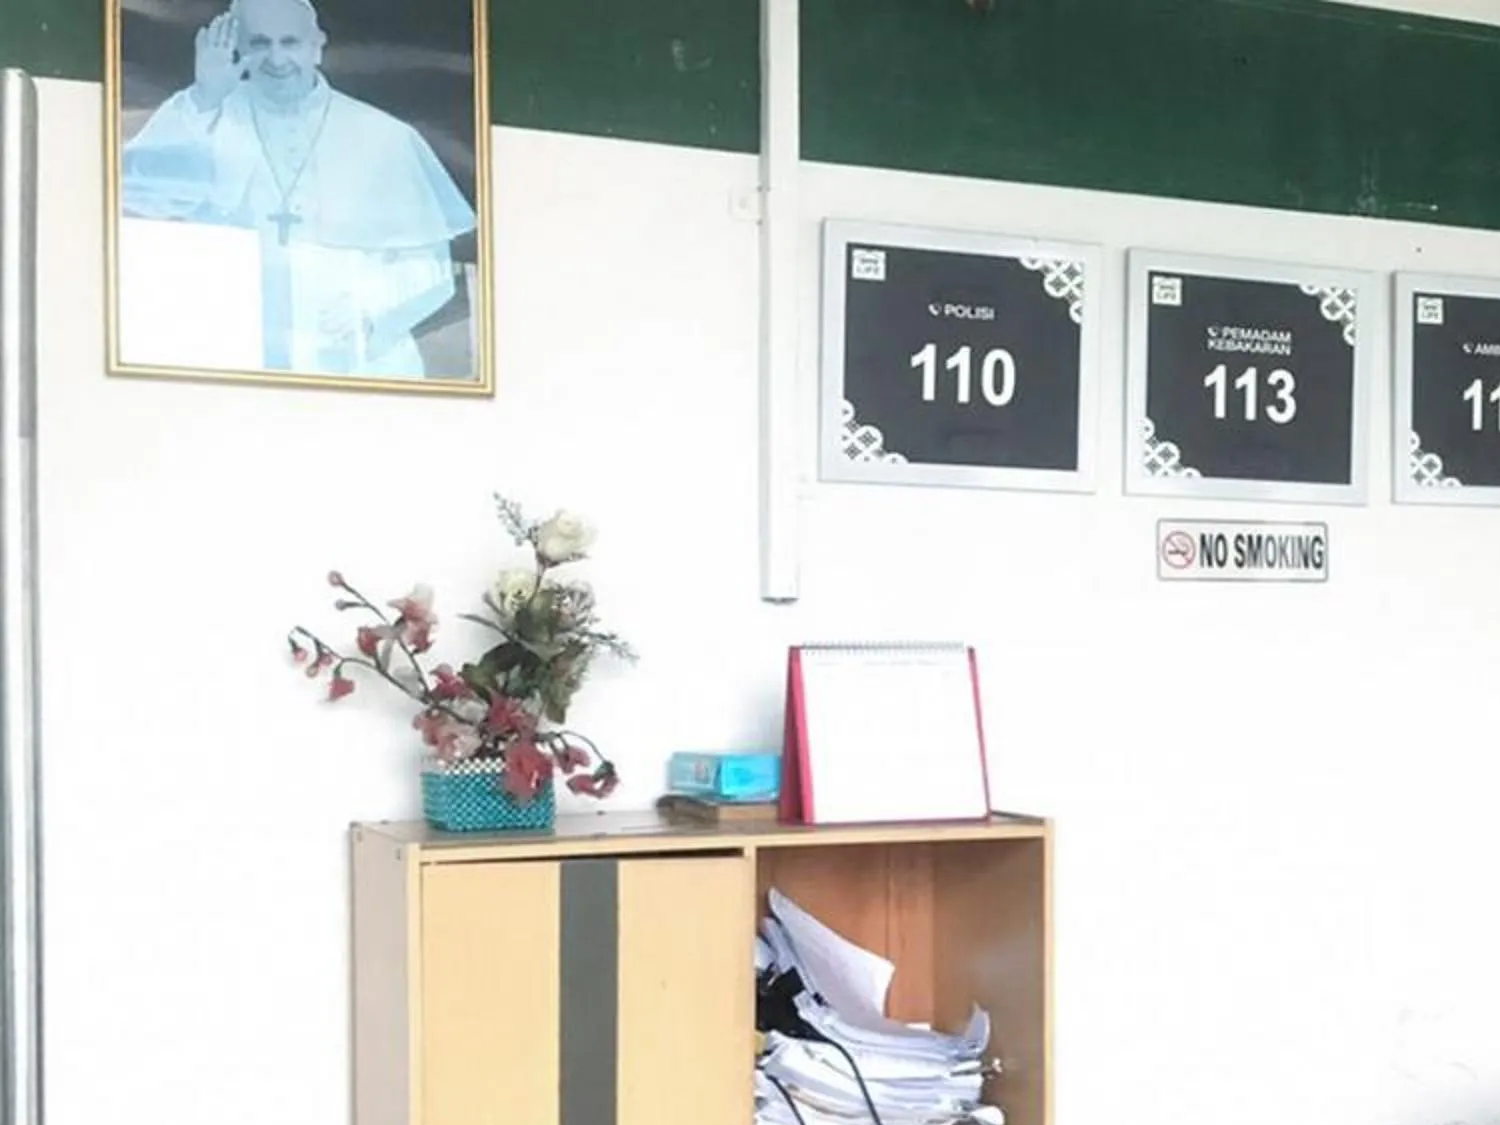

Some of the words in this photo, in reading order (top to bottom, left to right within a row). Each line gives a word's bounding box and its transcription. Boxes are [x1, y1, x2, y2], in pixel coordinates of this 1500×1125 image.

[943, 303, 996, 321] POLISI
[1206, 338, 1292, 356] KEBAKARAN
[1221, 326, 1292, 342] PEMADAM
[910, 343, 1017, 408] 110
[1203, 363, 1298, 425] 113
[1199, 533, 1229, 569] NO
[1233, 533, 1325, 570] SMOKING
